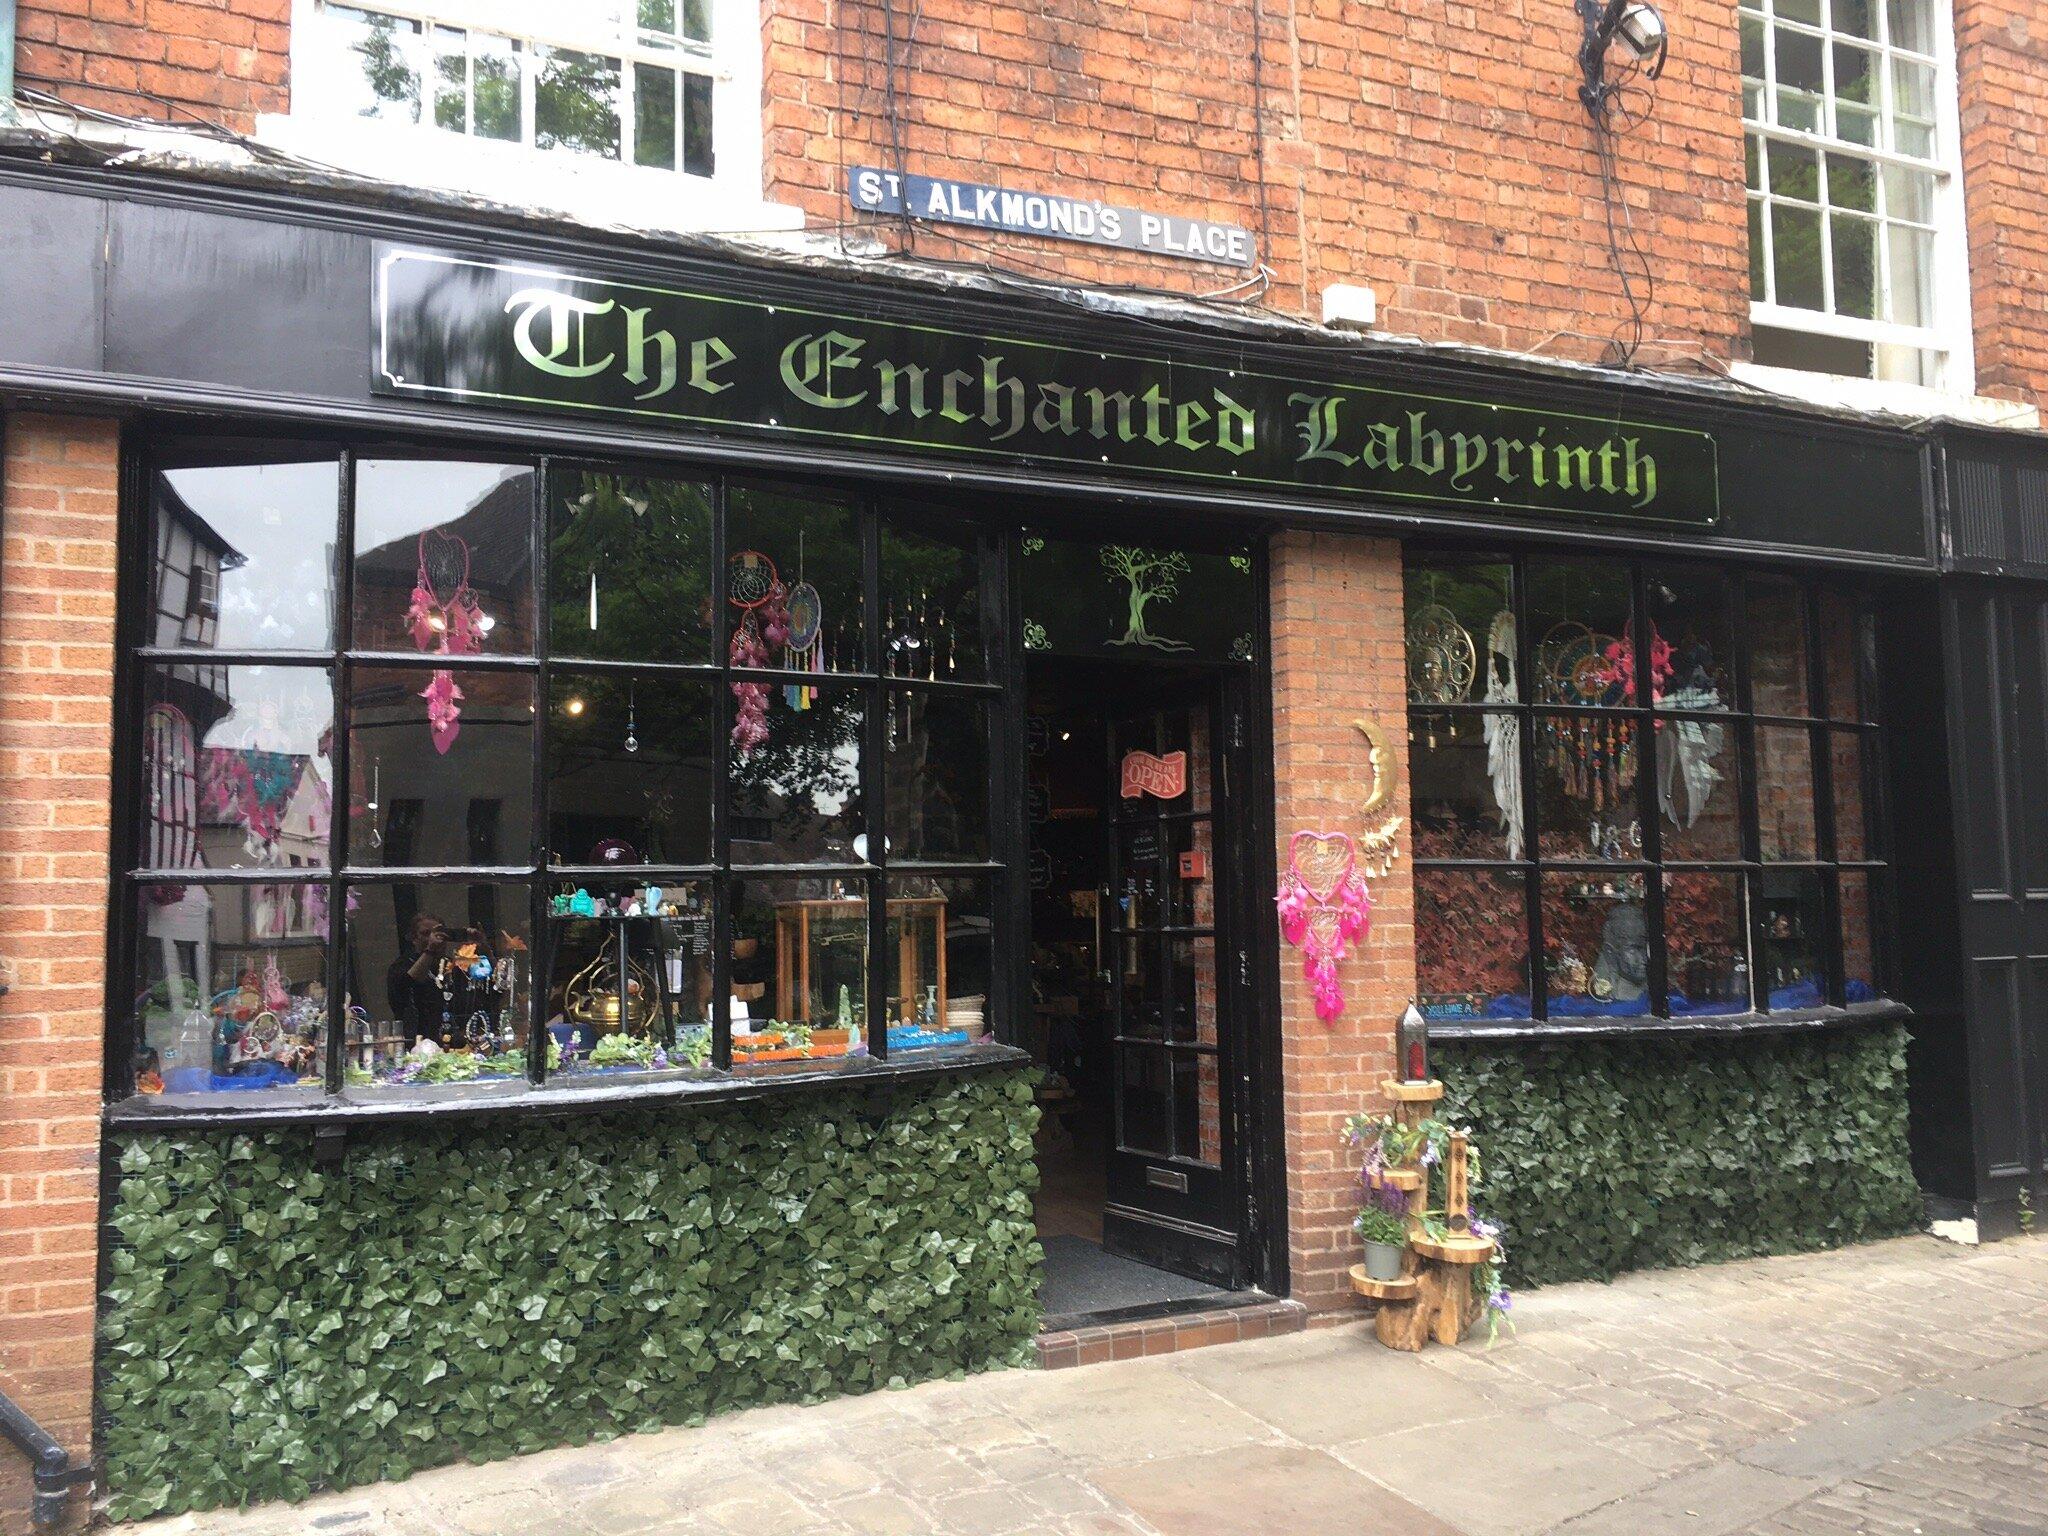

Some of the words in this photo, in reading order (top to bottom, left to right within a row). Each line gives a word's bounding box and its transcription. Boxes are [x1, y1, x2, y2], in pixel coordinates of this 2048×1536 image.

[927, 181, 1123, 241] ALKMOND'S
[1140, 214, 1248, 262] PLACE
[504, 287, 738, 401] The
[779, 329, 1256, 456] Enchanted
[1286, 391, 1659, 509] Labyrinth
[1128, 763, 1178, 793] OPEN
